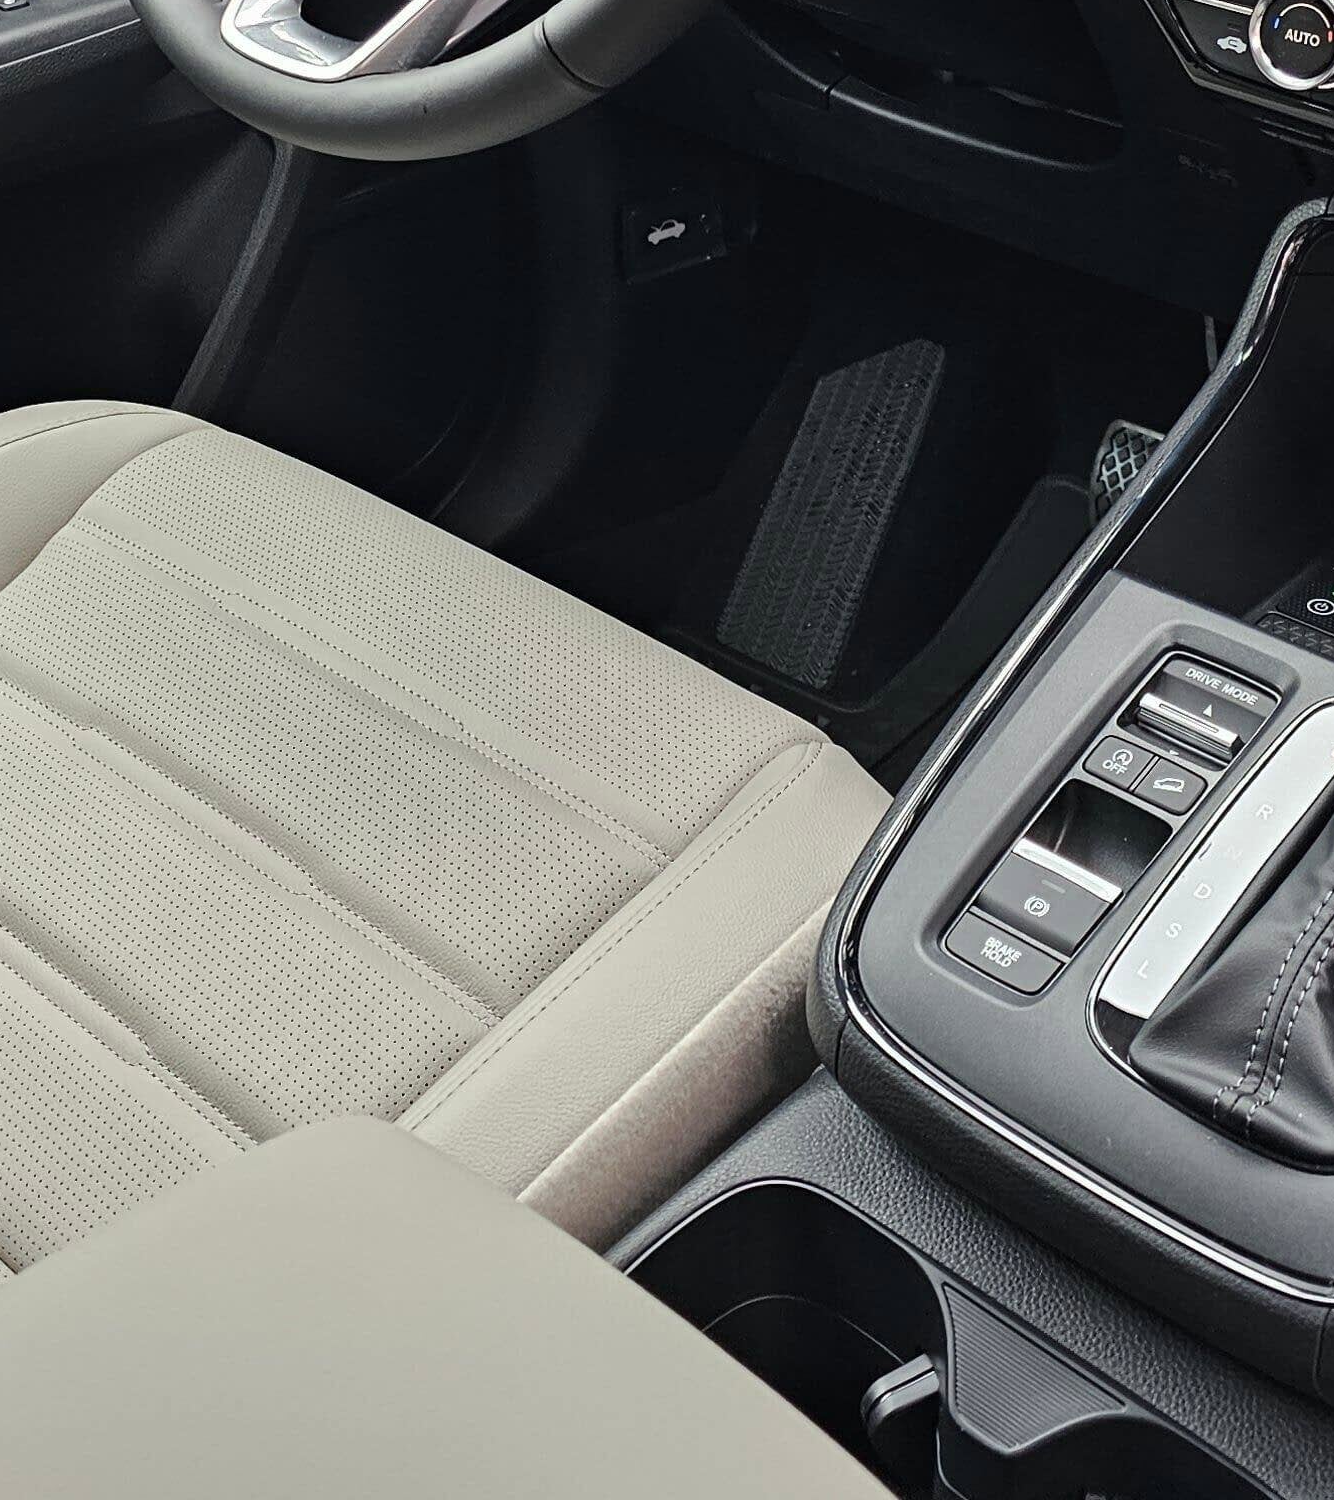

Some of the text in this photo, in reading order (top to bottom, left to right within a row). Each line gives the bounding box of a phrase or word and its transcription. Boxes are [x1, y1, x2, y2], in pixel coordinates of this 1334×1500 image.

[1284, 28, 1320, 47] AUTO
[1185, 667, 1259, 706] DRIVE MODE
[1102, 759, 1128, 776] OFF
[1256, 804, 1274, 820] R
[1194, 882, 1212, 900] D
[1165, 922, 1183, 939] S
[980, 946, 1012, 968] HOLD
[985, 936, 1022, 962] BRAKE
[1137, 959, 1151, 979] L
